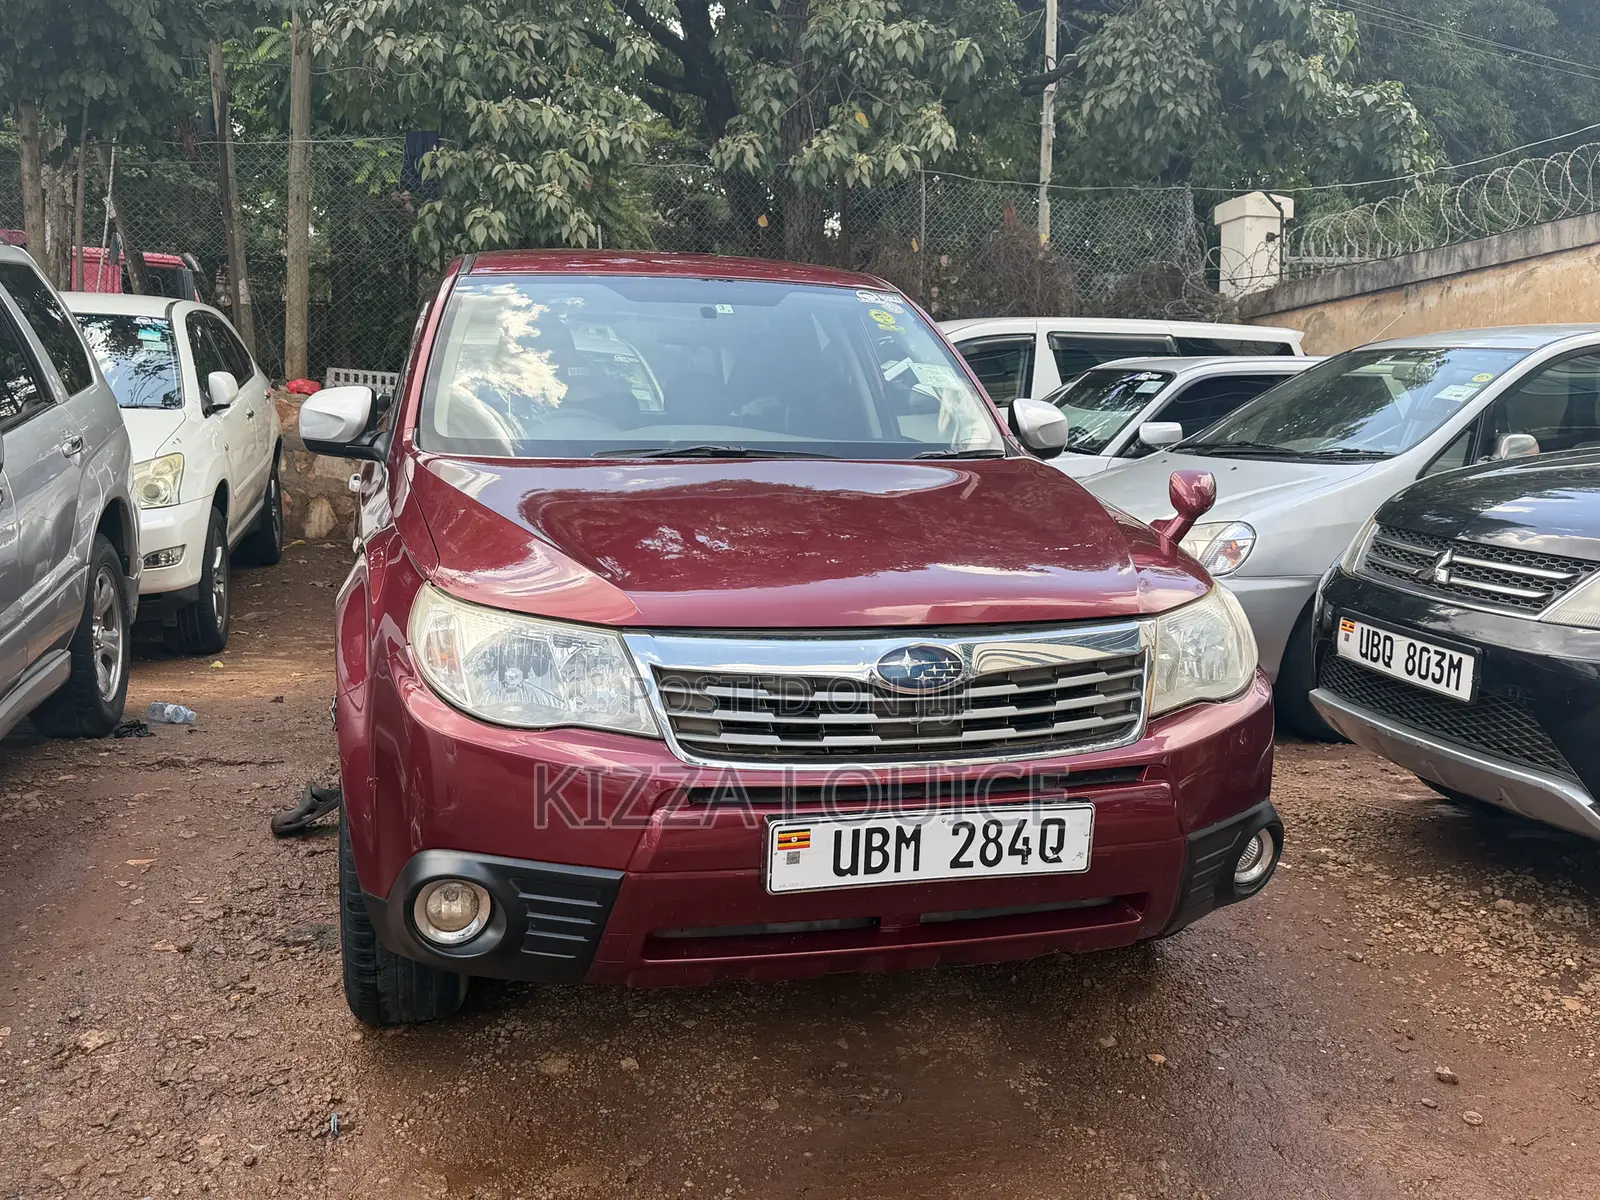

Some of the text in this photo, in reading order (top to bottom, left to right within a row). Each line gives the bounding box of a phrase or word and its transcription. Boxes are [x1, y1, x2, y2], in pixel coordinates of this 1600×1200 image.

[1359, 626, 1463, 691] UBQ 803M
[833, 818, 1067, 877] UBM 284Q
